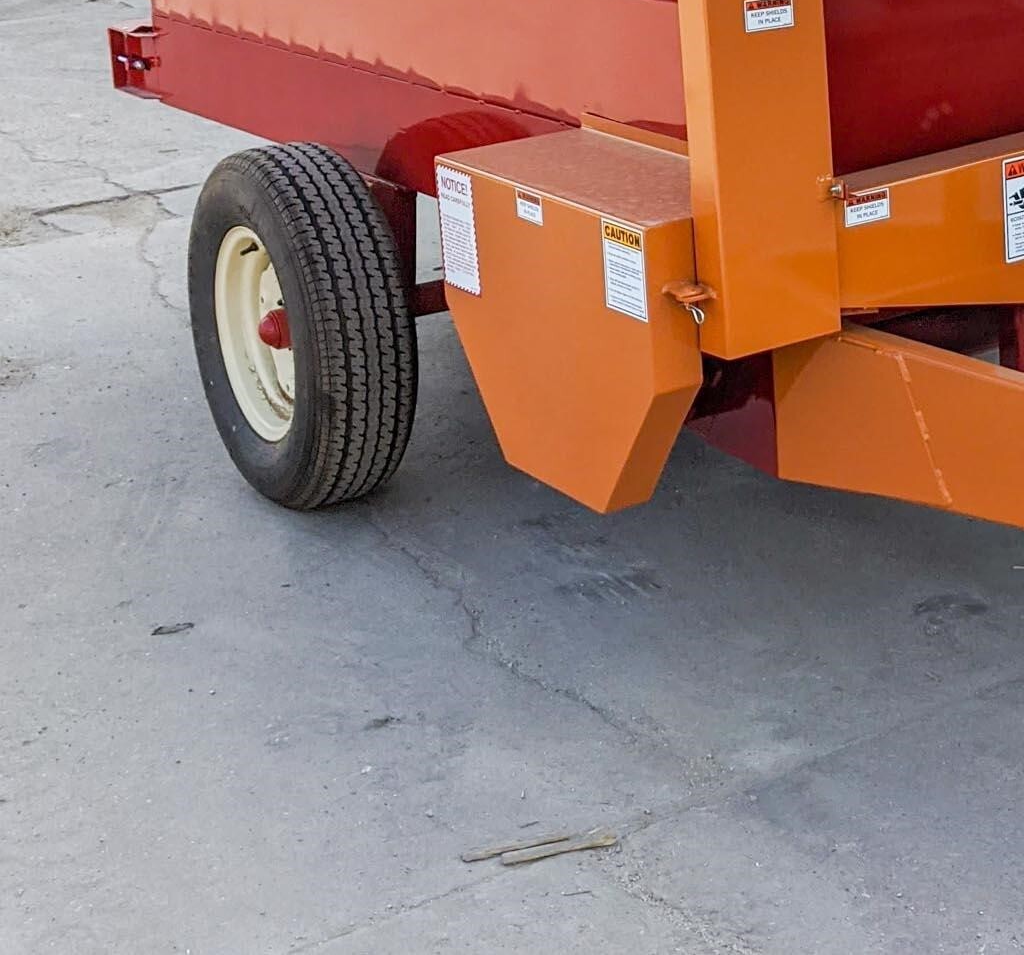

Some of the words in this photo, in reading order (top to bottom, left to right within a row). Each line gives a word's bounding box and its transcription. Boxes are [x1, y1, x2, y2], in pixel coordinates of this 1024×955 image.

[766, 8, 788, 16] SHIELDS
[441, 175, 468, 196] NOTICE!
[604, 225, 640, 247] CAUTION
